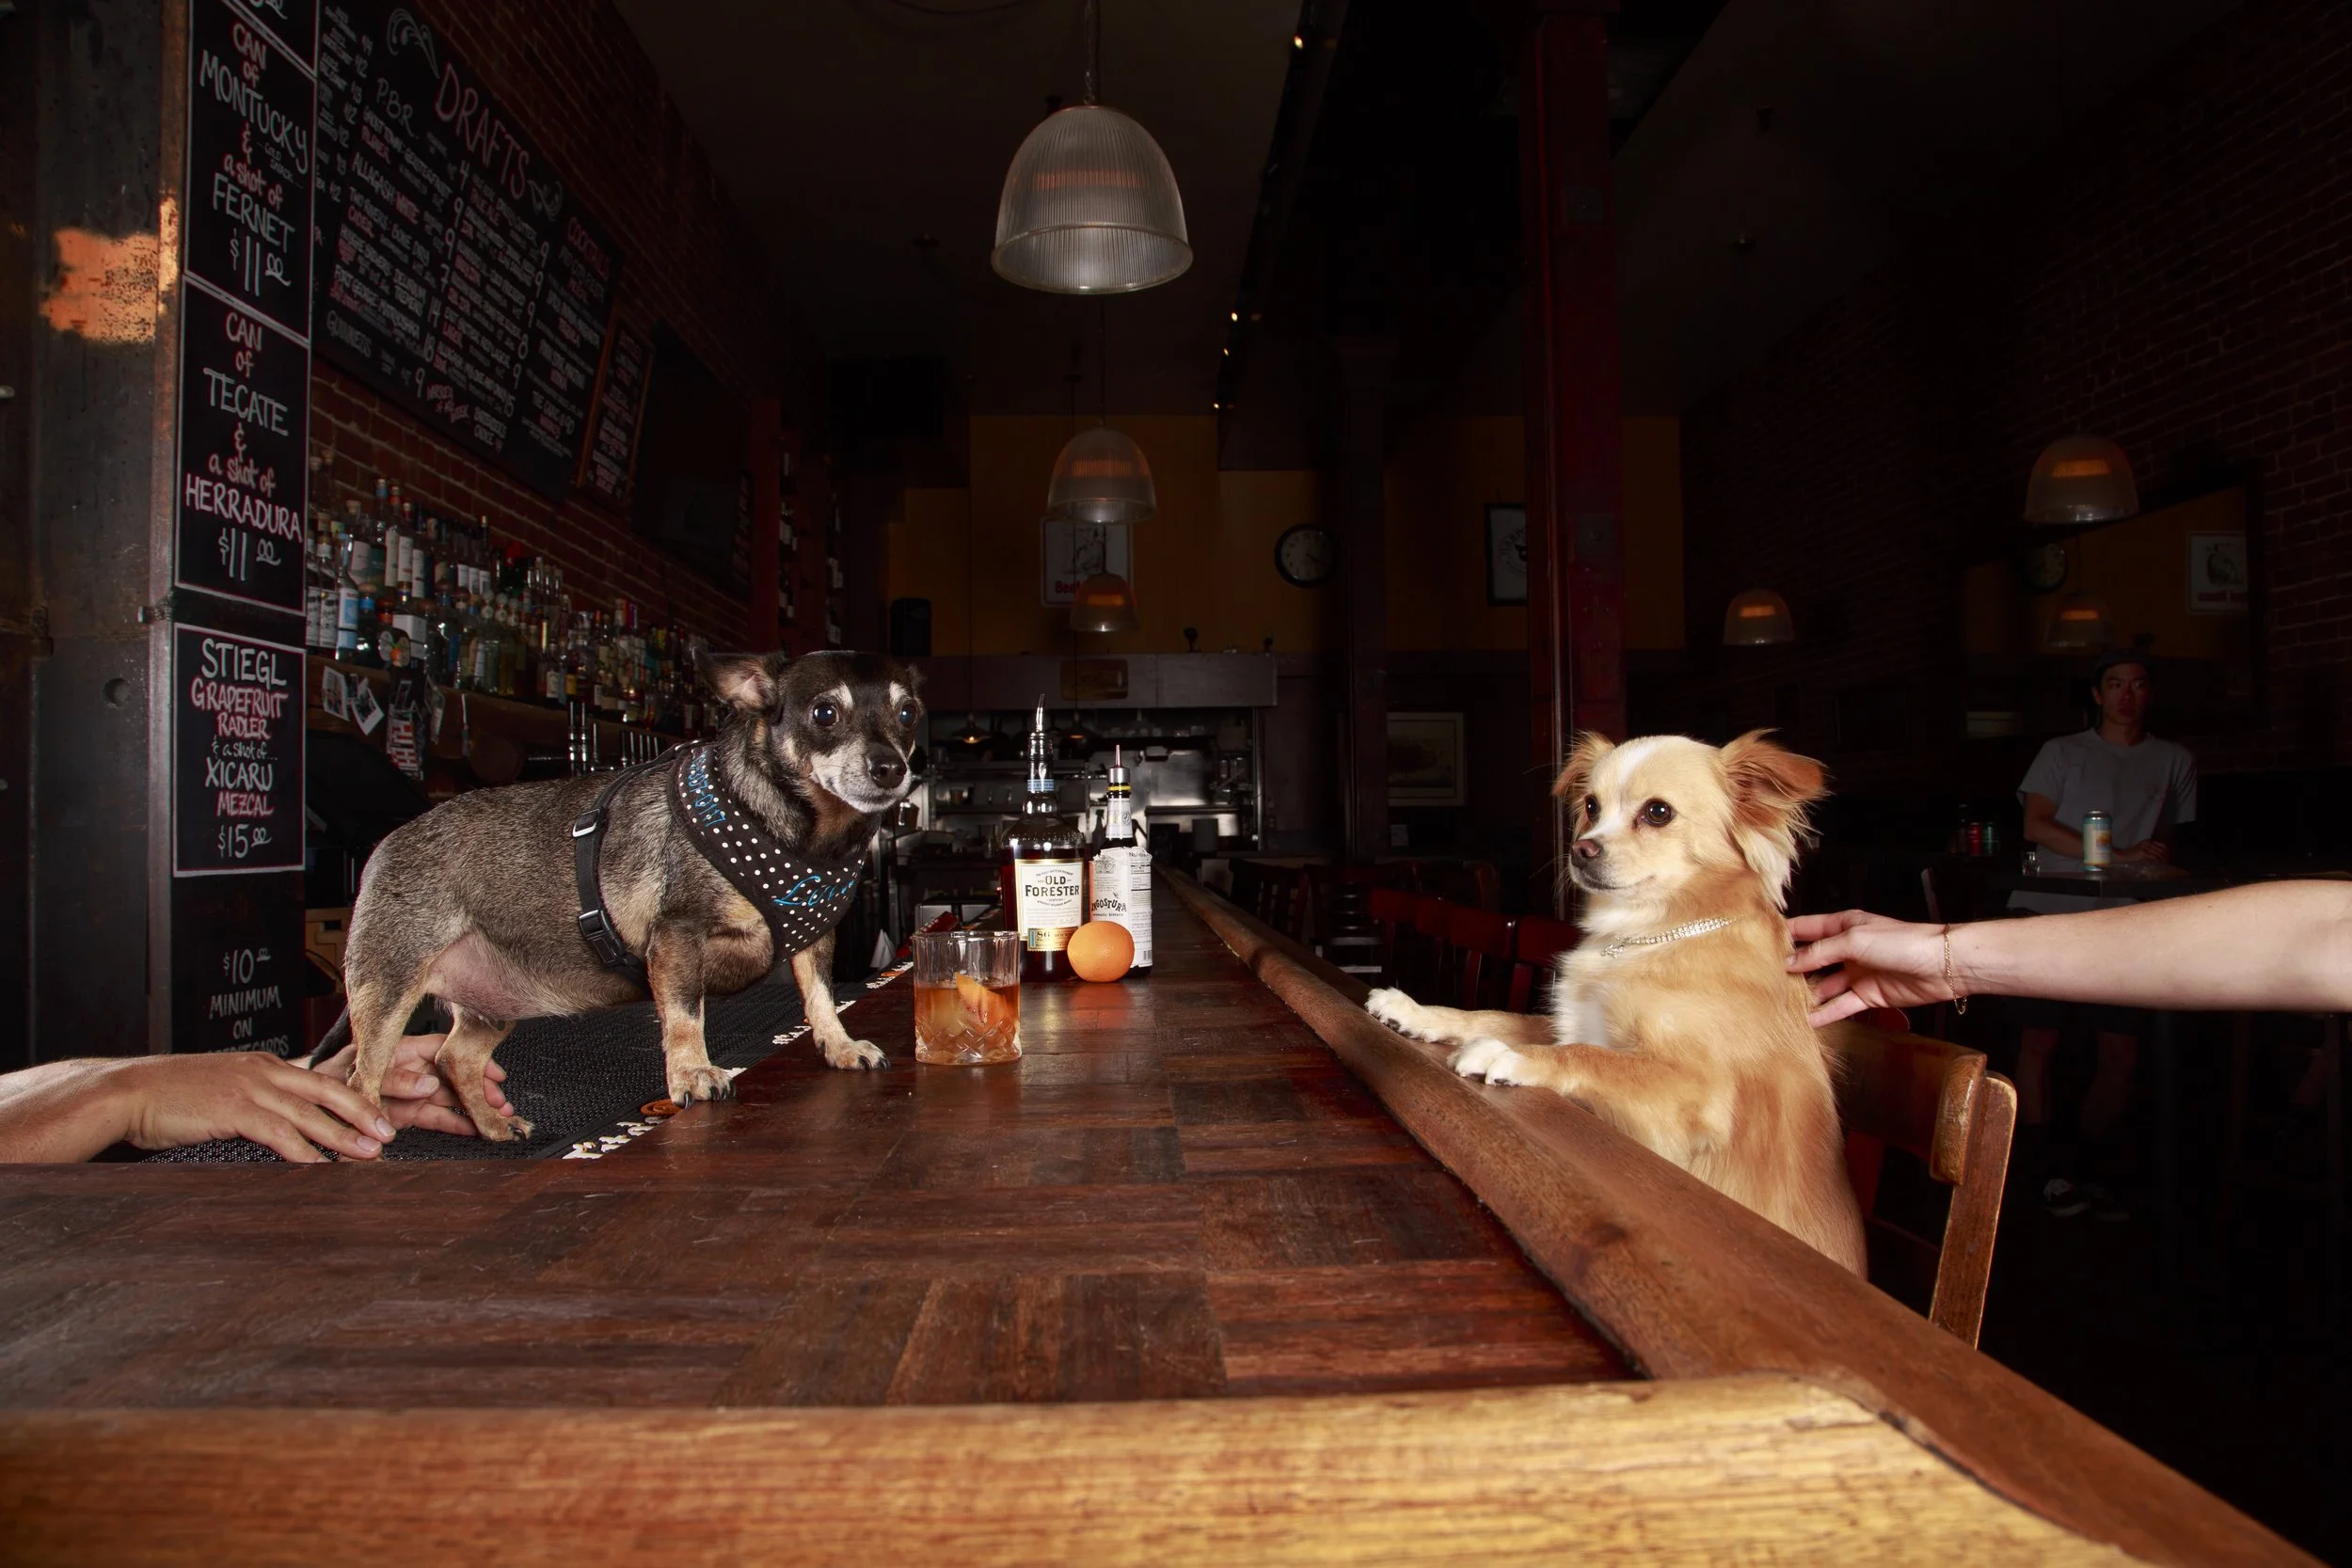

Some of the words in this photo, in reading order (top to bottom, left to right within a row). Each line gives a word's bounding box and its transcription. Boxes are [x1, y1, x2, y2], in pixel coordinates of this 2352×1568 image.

[232, 23, 266, 71] CAN
[243, 60, 261, 88] of
[199, 49, 308, 175] MONTUCKY
[434, 60, 531, 201] DRAFTS
[213, 171, 296, 253] FERNET
[267, 183, 283, 212] of
[453, 197, 464, 229] 9
[445, 227, 455, 261] 9
[540, 241, 549, 268] 9
[534, 270, 544, 298] 9
[527, 300, 536, 328] 9
[226, 310, 262, 353] CAN
[235, 350, 255, 378] of
[512, 363, 522, 389] 9
[415, 367, 425, 398] 9
[203, 367, 289, 436] TECATE
[209, 452, 222, 475] a
[259, 467, 277, 499] of
[185, 473, 303, 544] HERRADURA
[201, 638, 287, 690] STIEGL
[191, 676, 289, 720] GRAPEFRUIT
[217, 711, 272, 740] RADLER
[205, 756, 273, 792] XICARU
[216, 791, 275, 816] MEZCAL
[1025, 884, 1080, 897] FORESTER
[1045, 876, 1066, 884] OLD
[209, 985, 282, 1021] MINIMUM
[232, 1017, 252, 1039] ON
